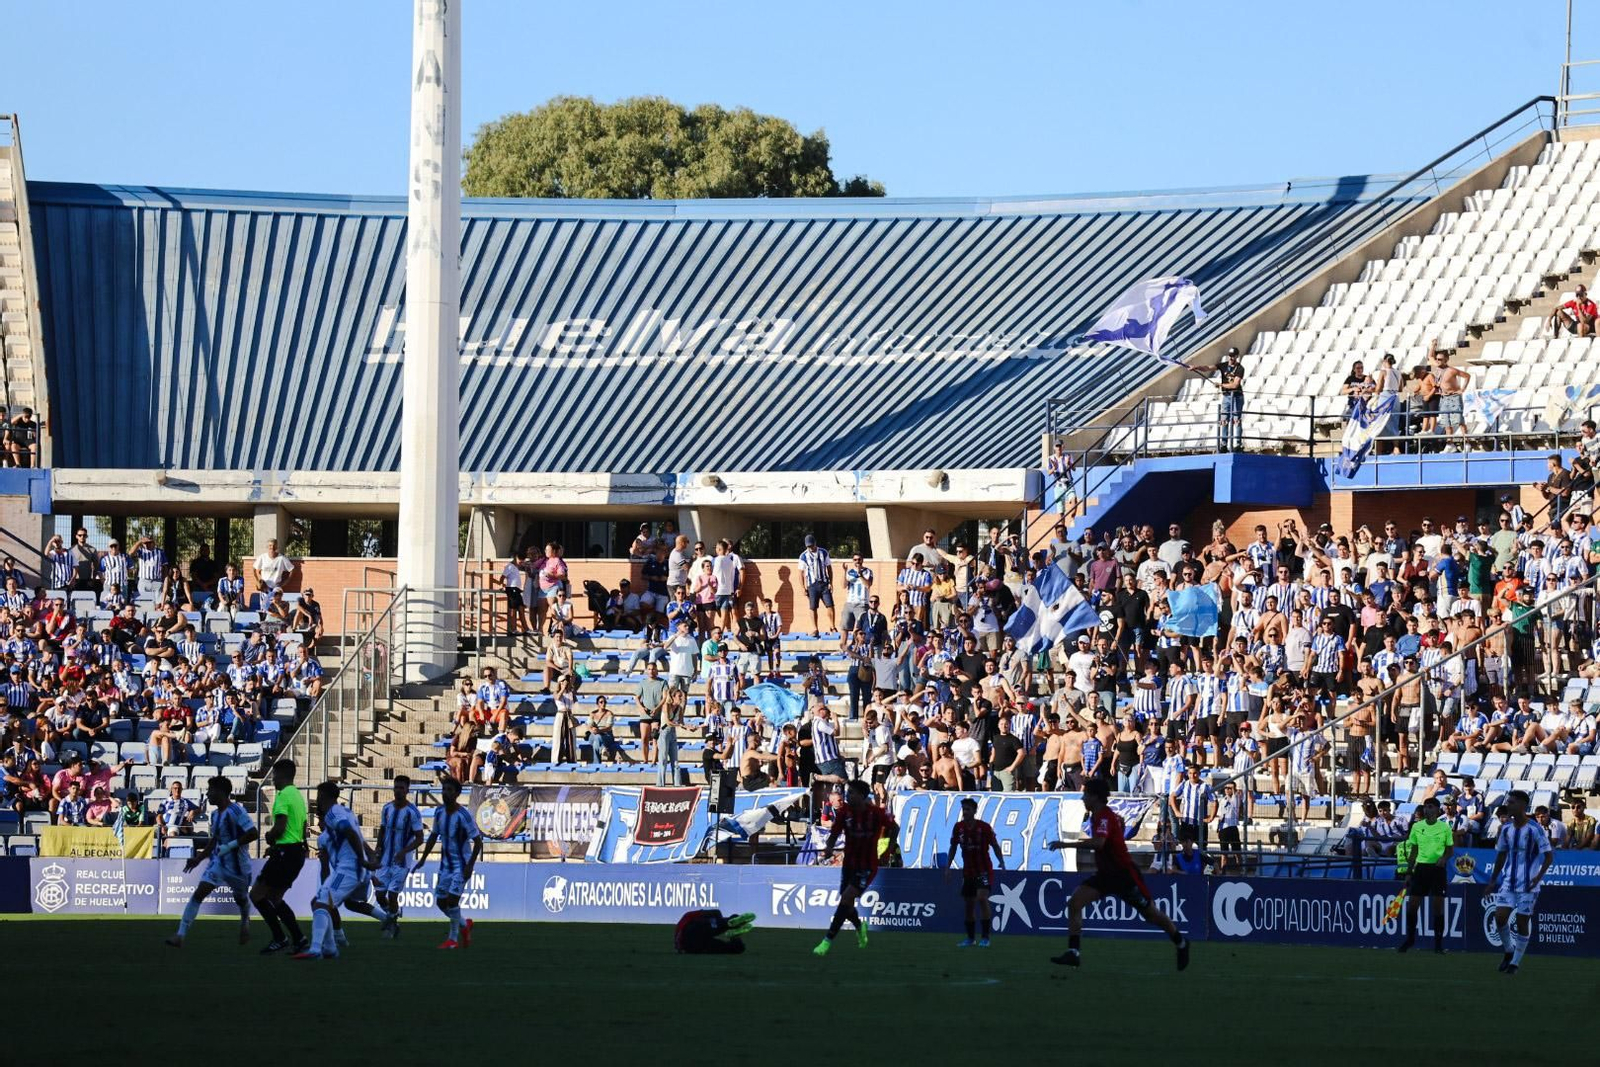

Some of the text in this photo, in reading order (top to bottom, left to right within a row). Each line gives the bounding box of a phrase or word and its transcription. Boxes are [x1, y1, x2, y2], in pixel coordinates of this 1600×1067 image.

[84, 849, 122, 857] DECANO
[76, 870, 125, 879] REAL CLUB
[405, 873, 429, 889] TEL
[75, 883, 155, 895] RECREATIVO
[568, 882, 719, 908] ATRACCIONES LA CINTA S.L.
[75, 898, 125, 907] DE HUELVA
[397, 891, 433, 908] ONSO
[808, 888, 880, 908] auo
[872, 902, 935, 918] PARTS
[1253, 897, 1354, 934] COPIADORAS
[869, 916, 922, 927] FRANQUICIA
[1538, 912, 1586, 924] DIPUTACIÓN
[1538, 923, 1585, 934] PROVINCIAL
[1546, 934, 1575, 943] HUELVA
